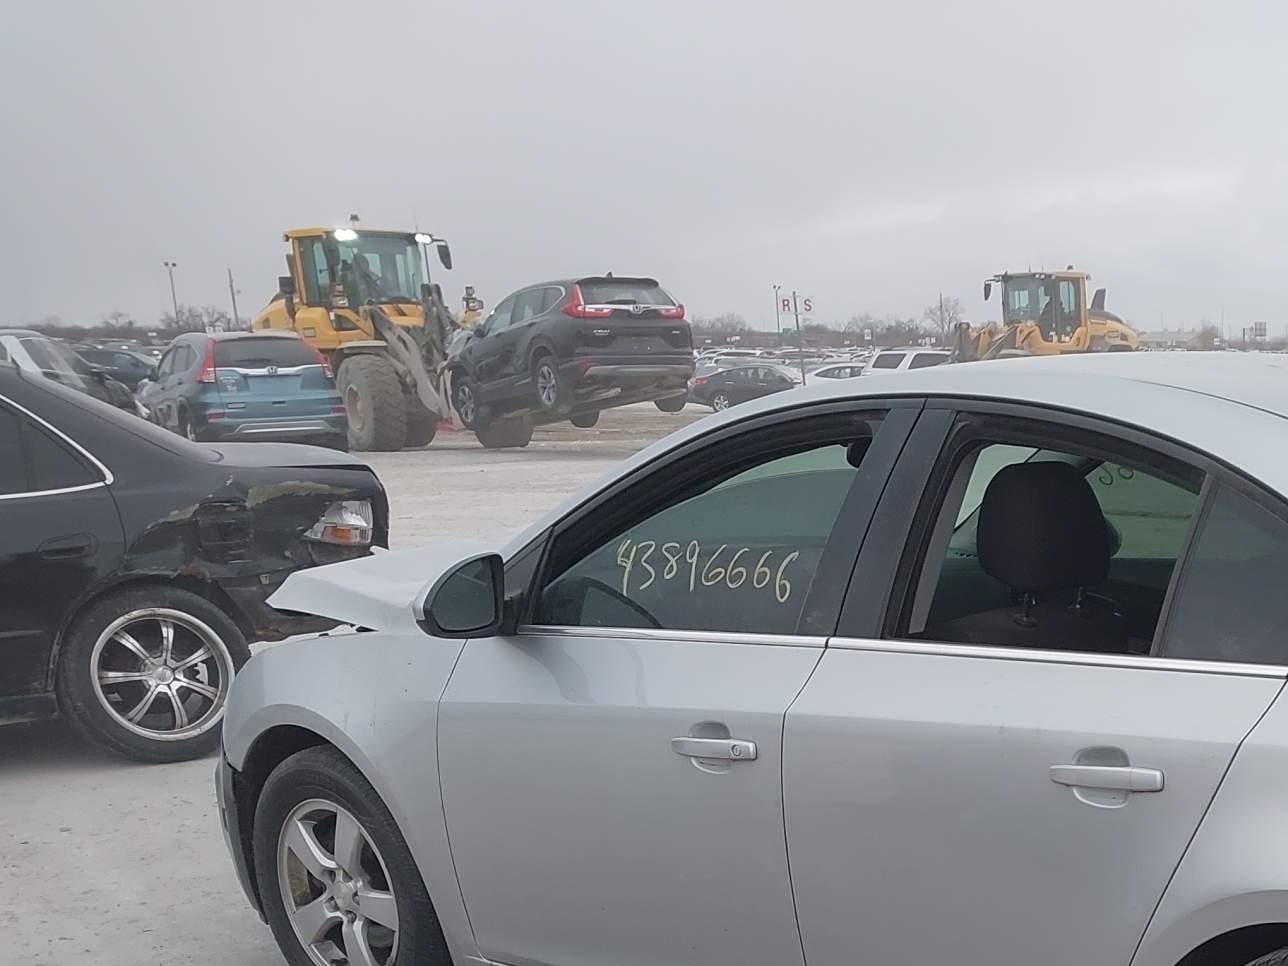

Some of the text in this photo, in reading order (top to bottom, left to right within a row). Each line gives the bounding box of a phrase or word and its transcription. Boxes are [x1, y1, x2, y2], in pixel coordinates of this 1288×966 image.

[782, 298, 812, 312] R S
[617, 540, 800, 603] 43896666
